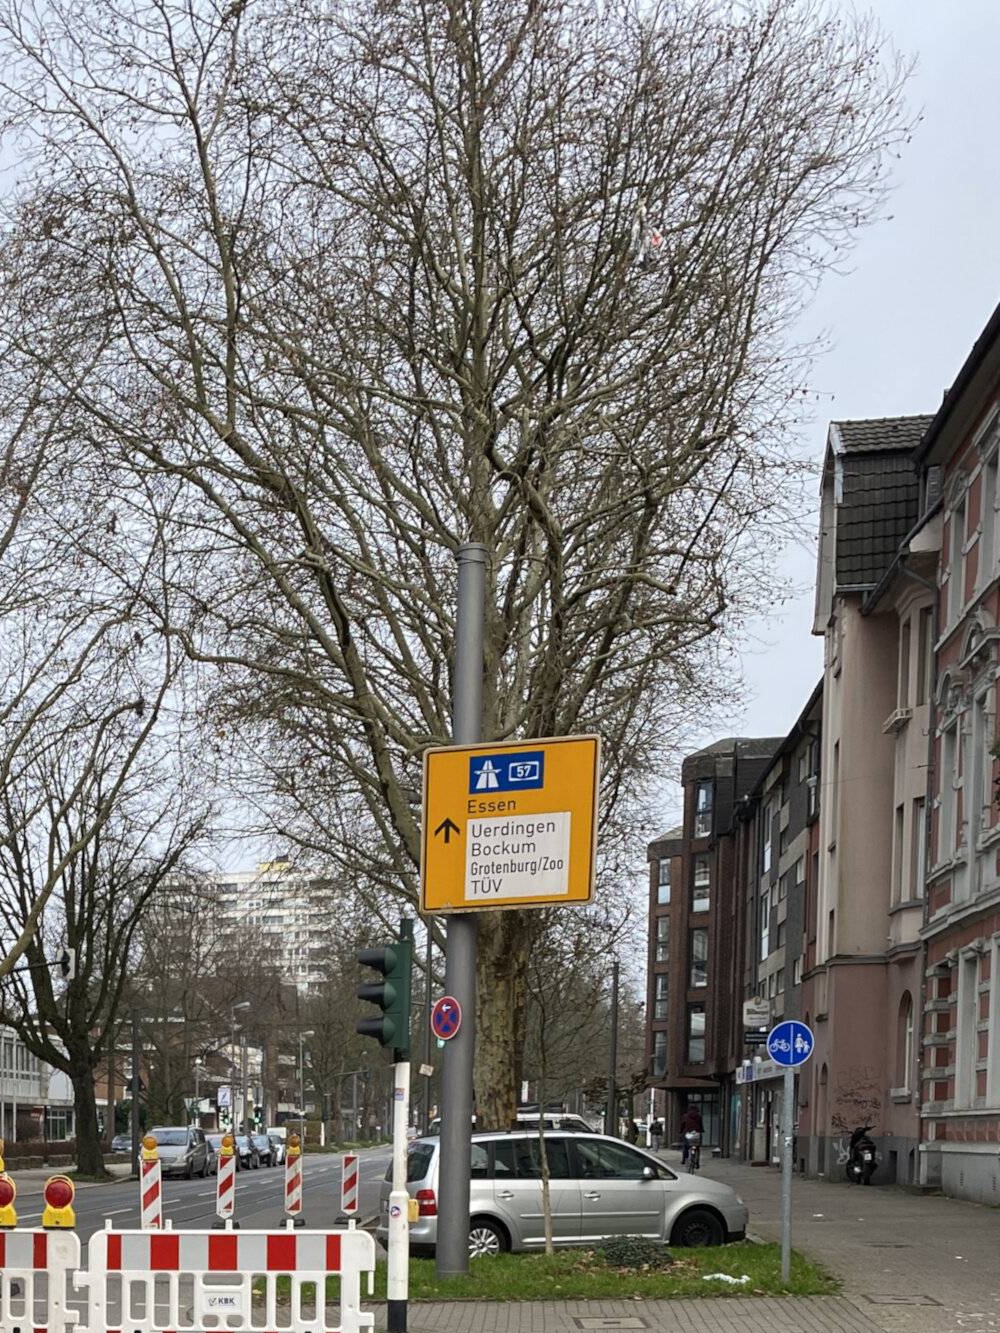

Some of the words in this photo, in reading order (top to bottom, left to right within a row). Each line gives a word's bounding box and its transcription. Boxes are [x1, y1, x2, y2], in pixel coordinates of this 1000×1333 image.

[516, 765, 532, 777] 57
[467, 799, 516, 814] Essen
[471, 820, 556, 839] Uerdingen
[471, 841, 536, 857] Bockum
[470, 856, 563, 877] Grotenburg/Zoo
[471, 876, 503, 894] TÜV
